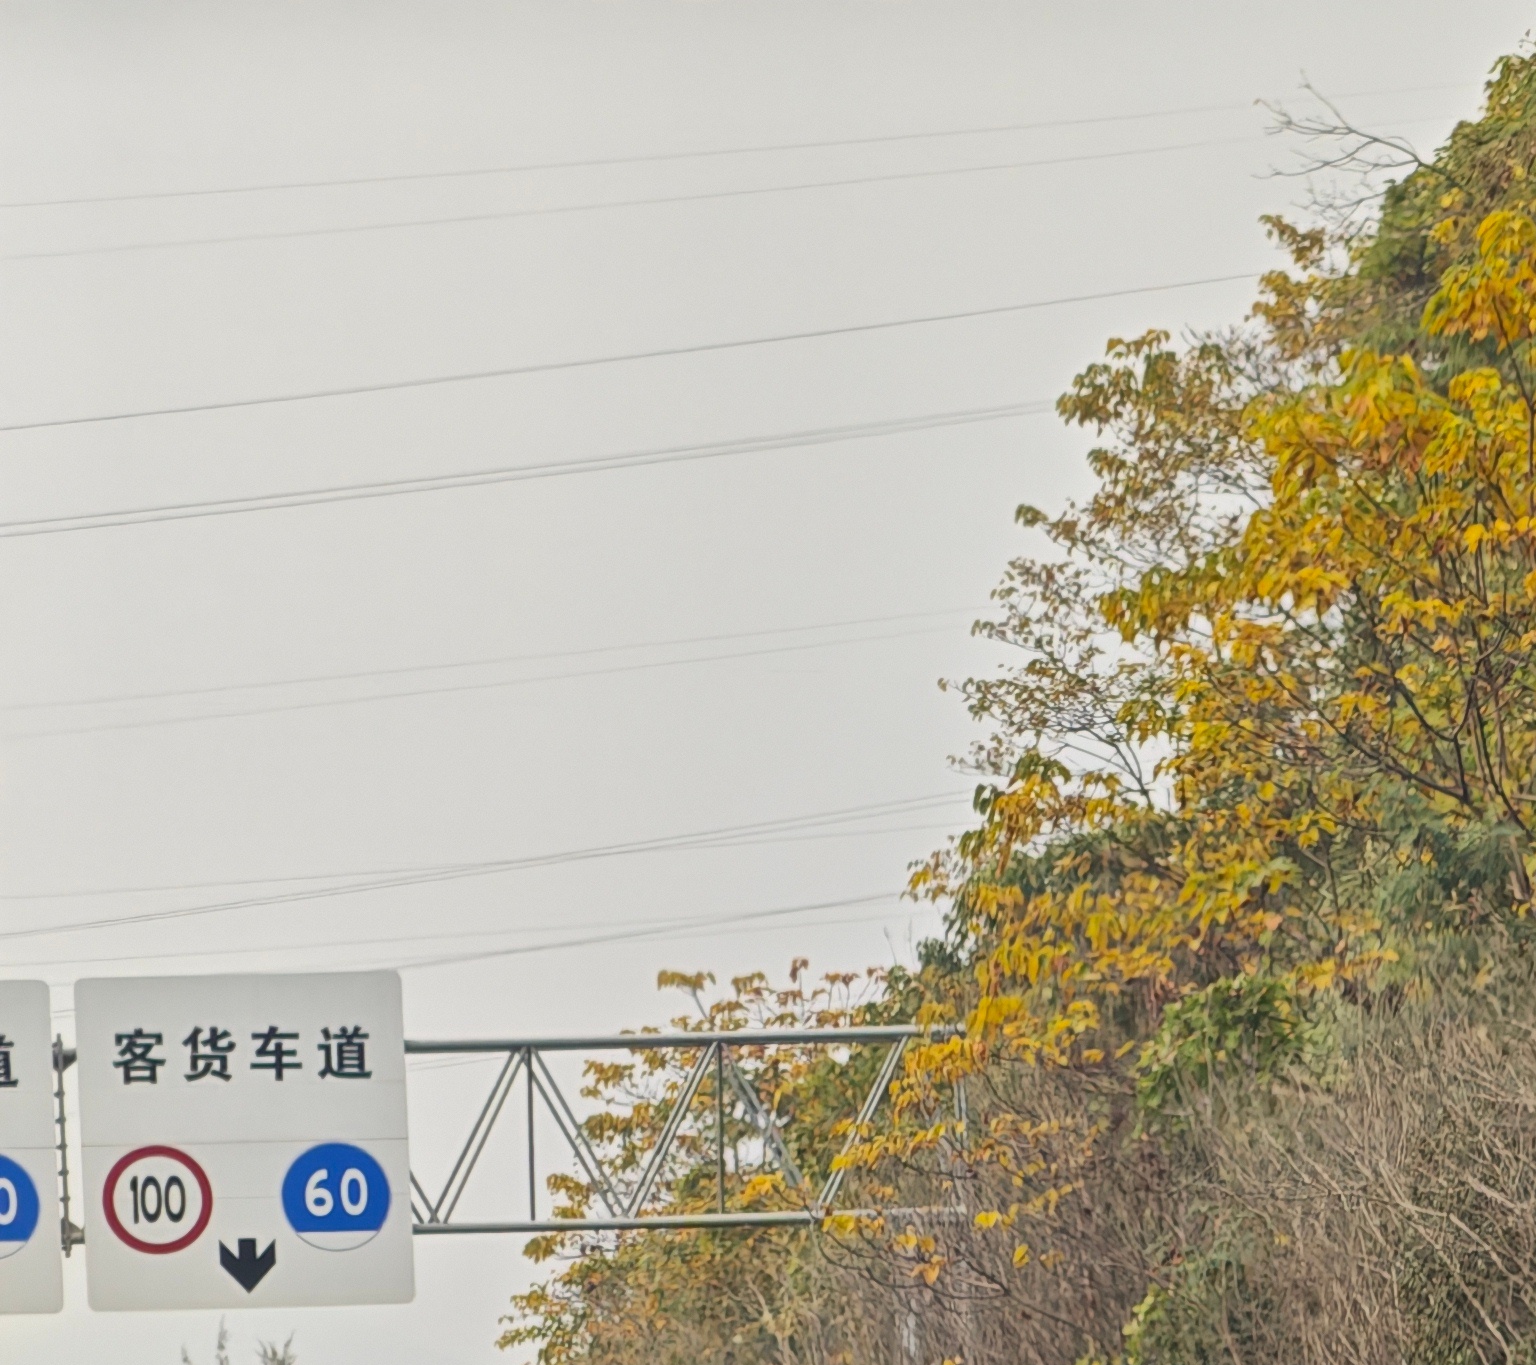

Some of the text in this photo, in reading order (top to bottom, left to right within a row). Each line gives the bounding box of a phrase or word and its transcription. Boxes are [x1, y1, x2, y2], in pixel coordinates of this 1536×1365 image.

[113, 1025, 373, 1085] 客货车道
[130, 1175, 187, 1225] 100
[305, 1167, 368, 1218] 60
